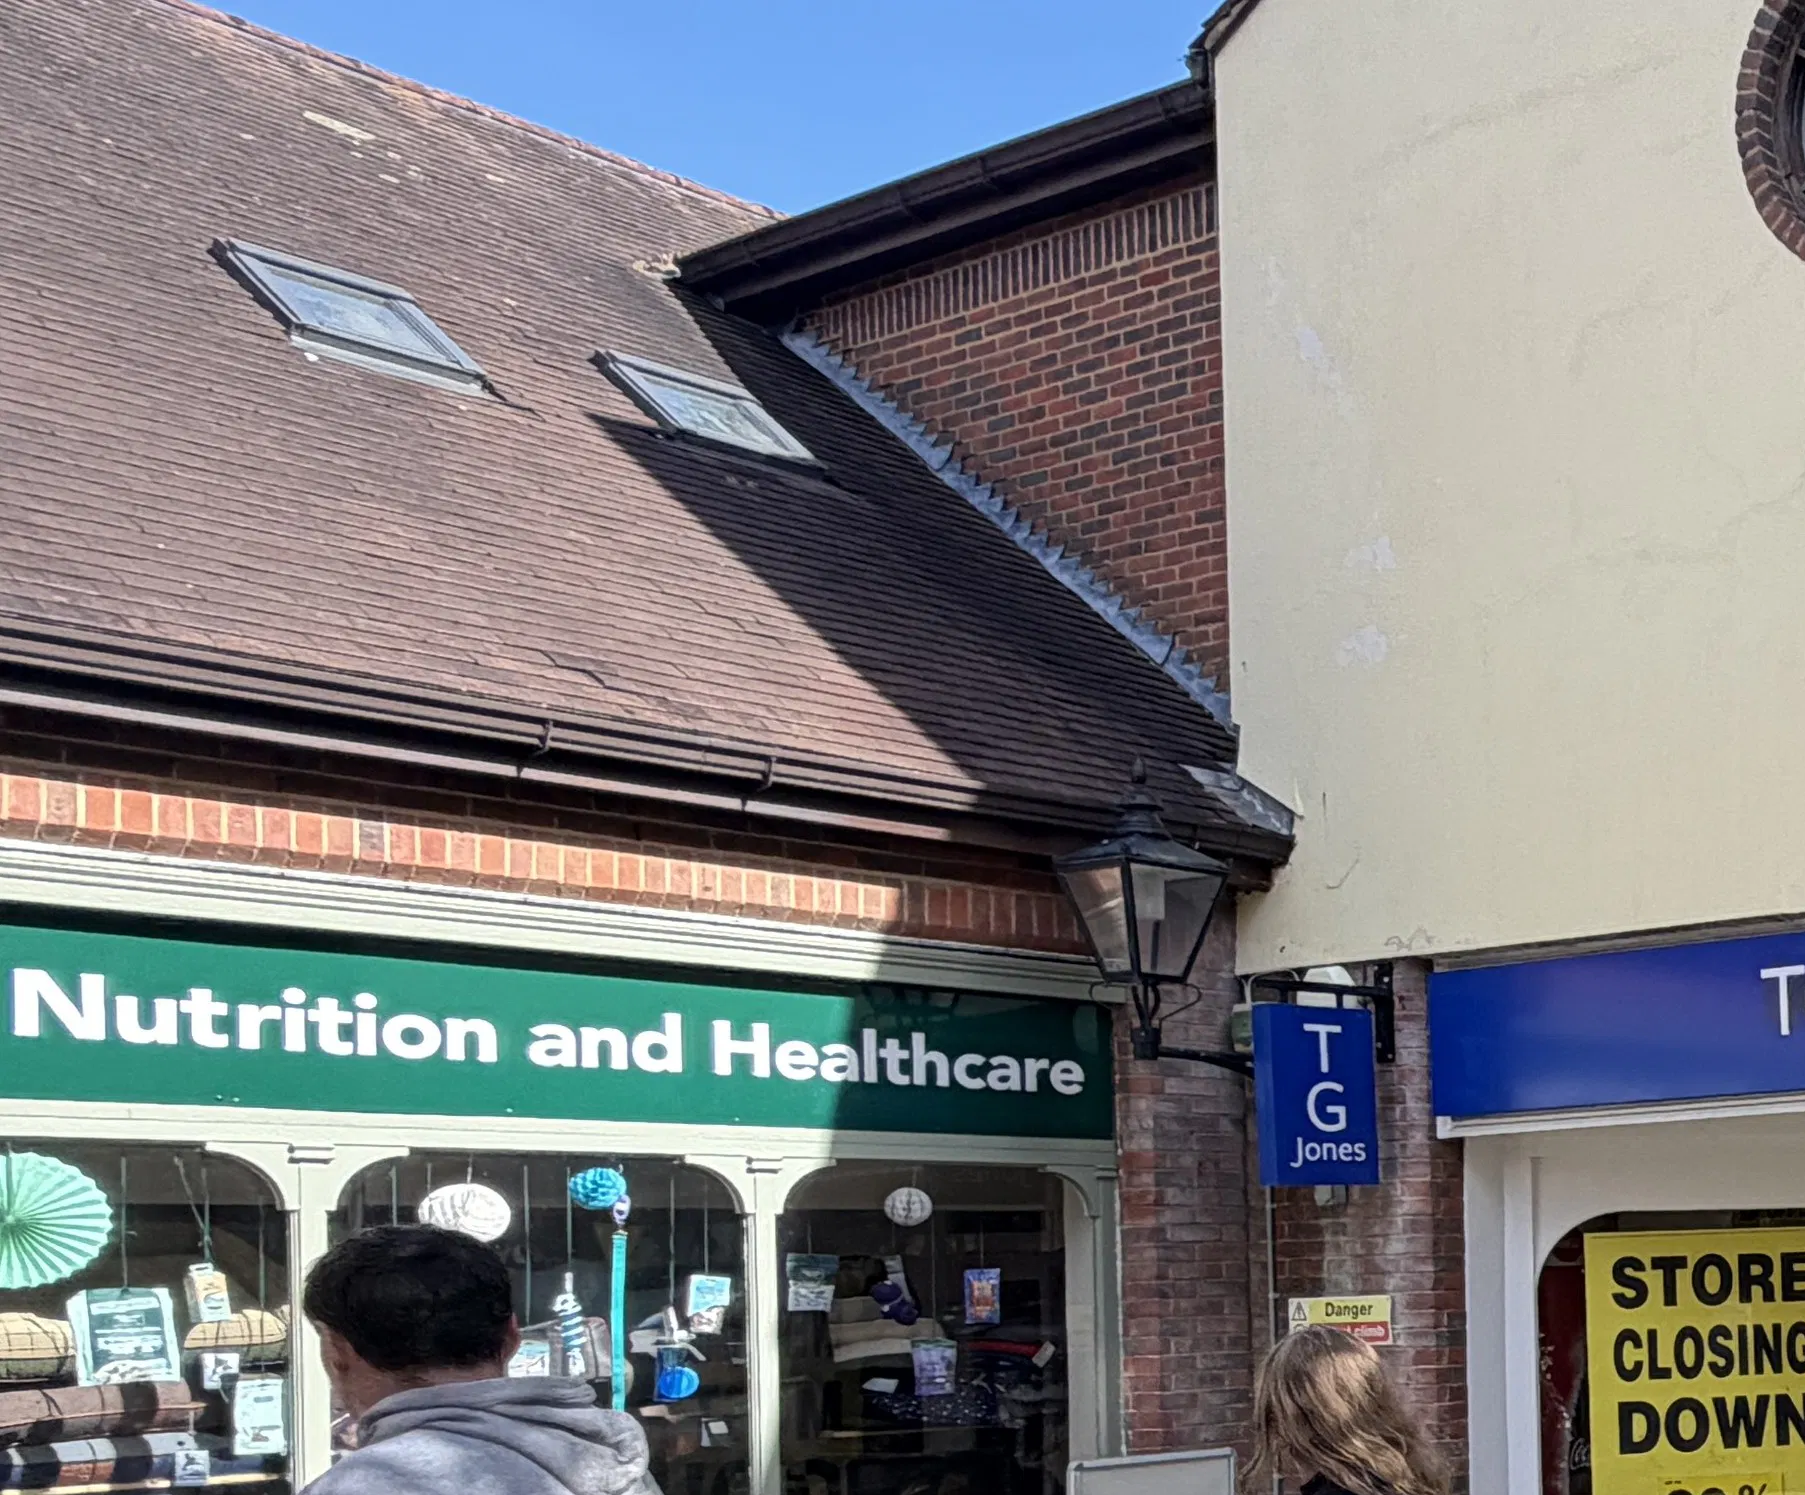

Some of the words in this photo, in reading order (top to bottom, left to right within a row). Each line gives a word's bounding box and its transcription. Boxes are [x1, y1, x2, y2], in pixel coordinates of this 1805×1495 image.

[12, 967, 498, 1063] Nutrition
[527, 1012, 683, 1073] and
[710, 1019, 1084, 1095] Healthcare
[1304, 1023, 1342, 1073] T
[1306, 1081, 1347, 1133] G
[1291, 1136, 1367, 1168] Jones
[1325, 1302, 1373, 1319] Danger
